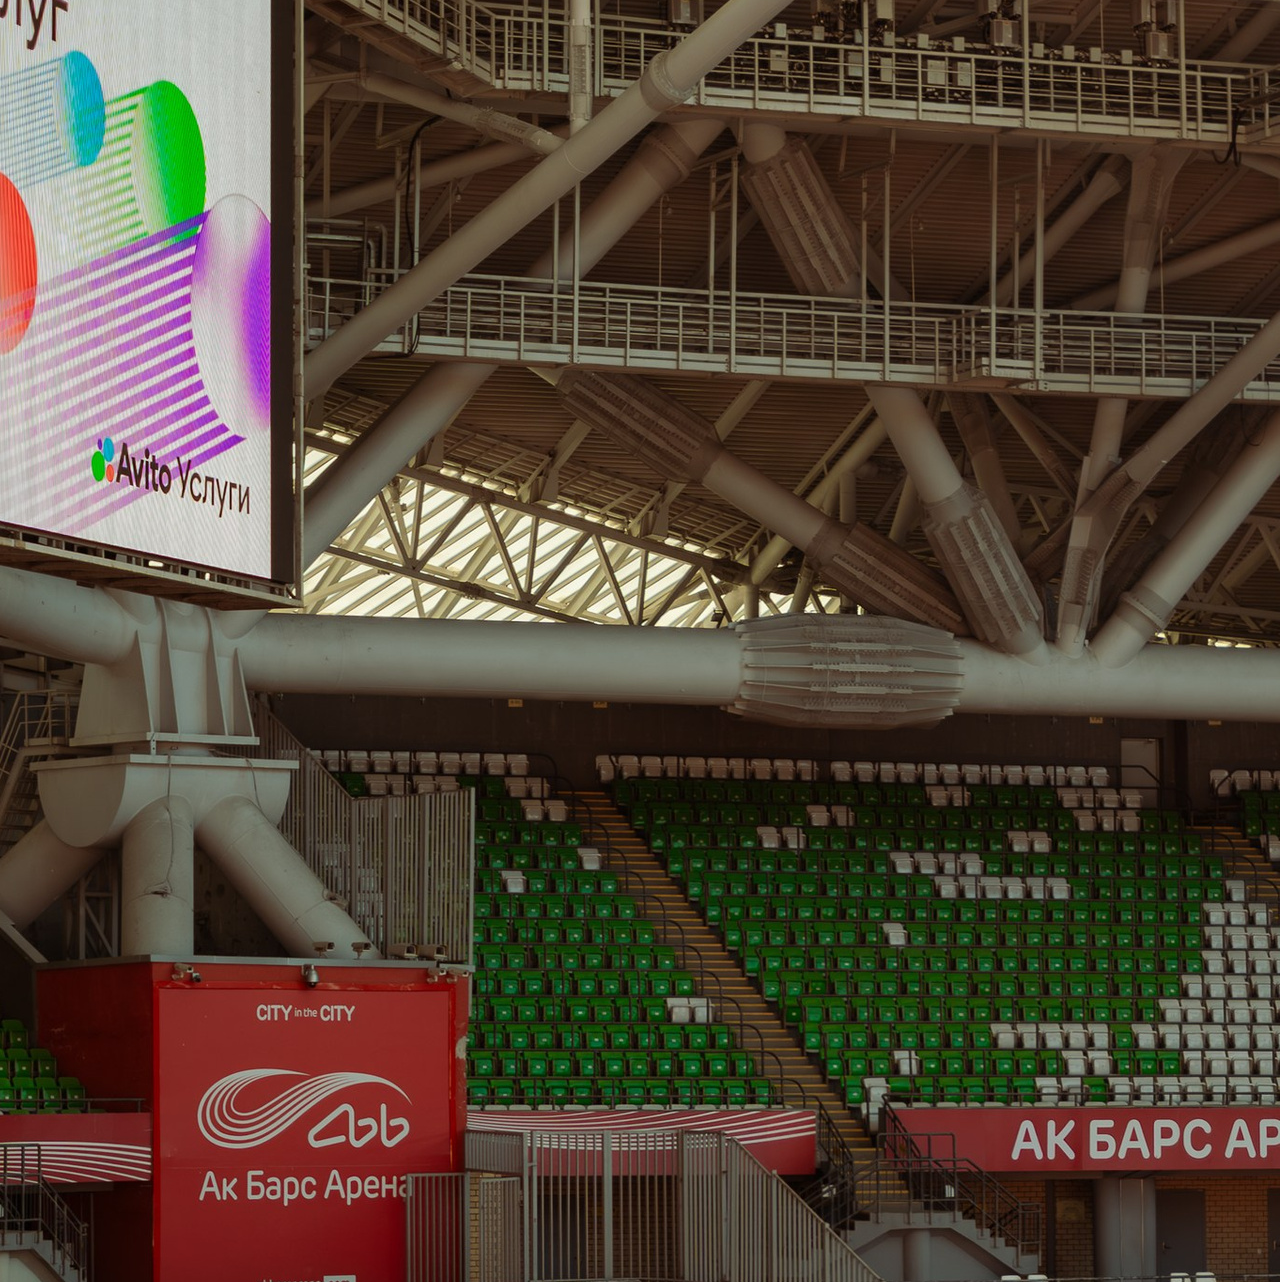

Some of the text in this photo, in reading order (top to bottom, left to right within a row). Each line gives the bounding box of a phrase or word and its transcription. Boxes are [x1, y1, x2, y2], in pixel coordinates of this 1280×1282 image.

[116, 442, 250, 518] Avito Услуги
[256, 1004, 356, 1022] CITY in the CITY
[1011, 1120, 1076, 1161] АК
[1089, 1119, 1213, 1160] БАРС
[198, 1170, 239, 1201] Ак
[246, 1170, 317, 1207] Барс
